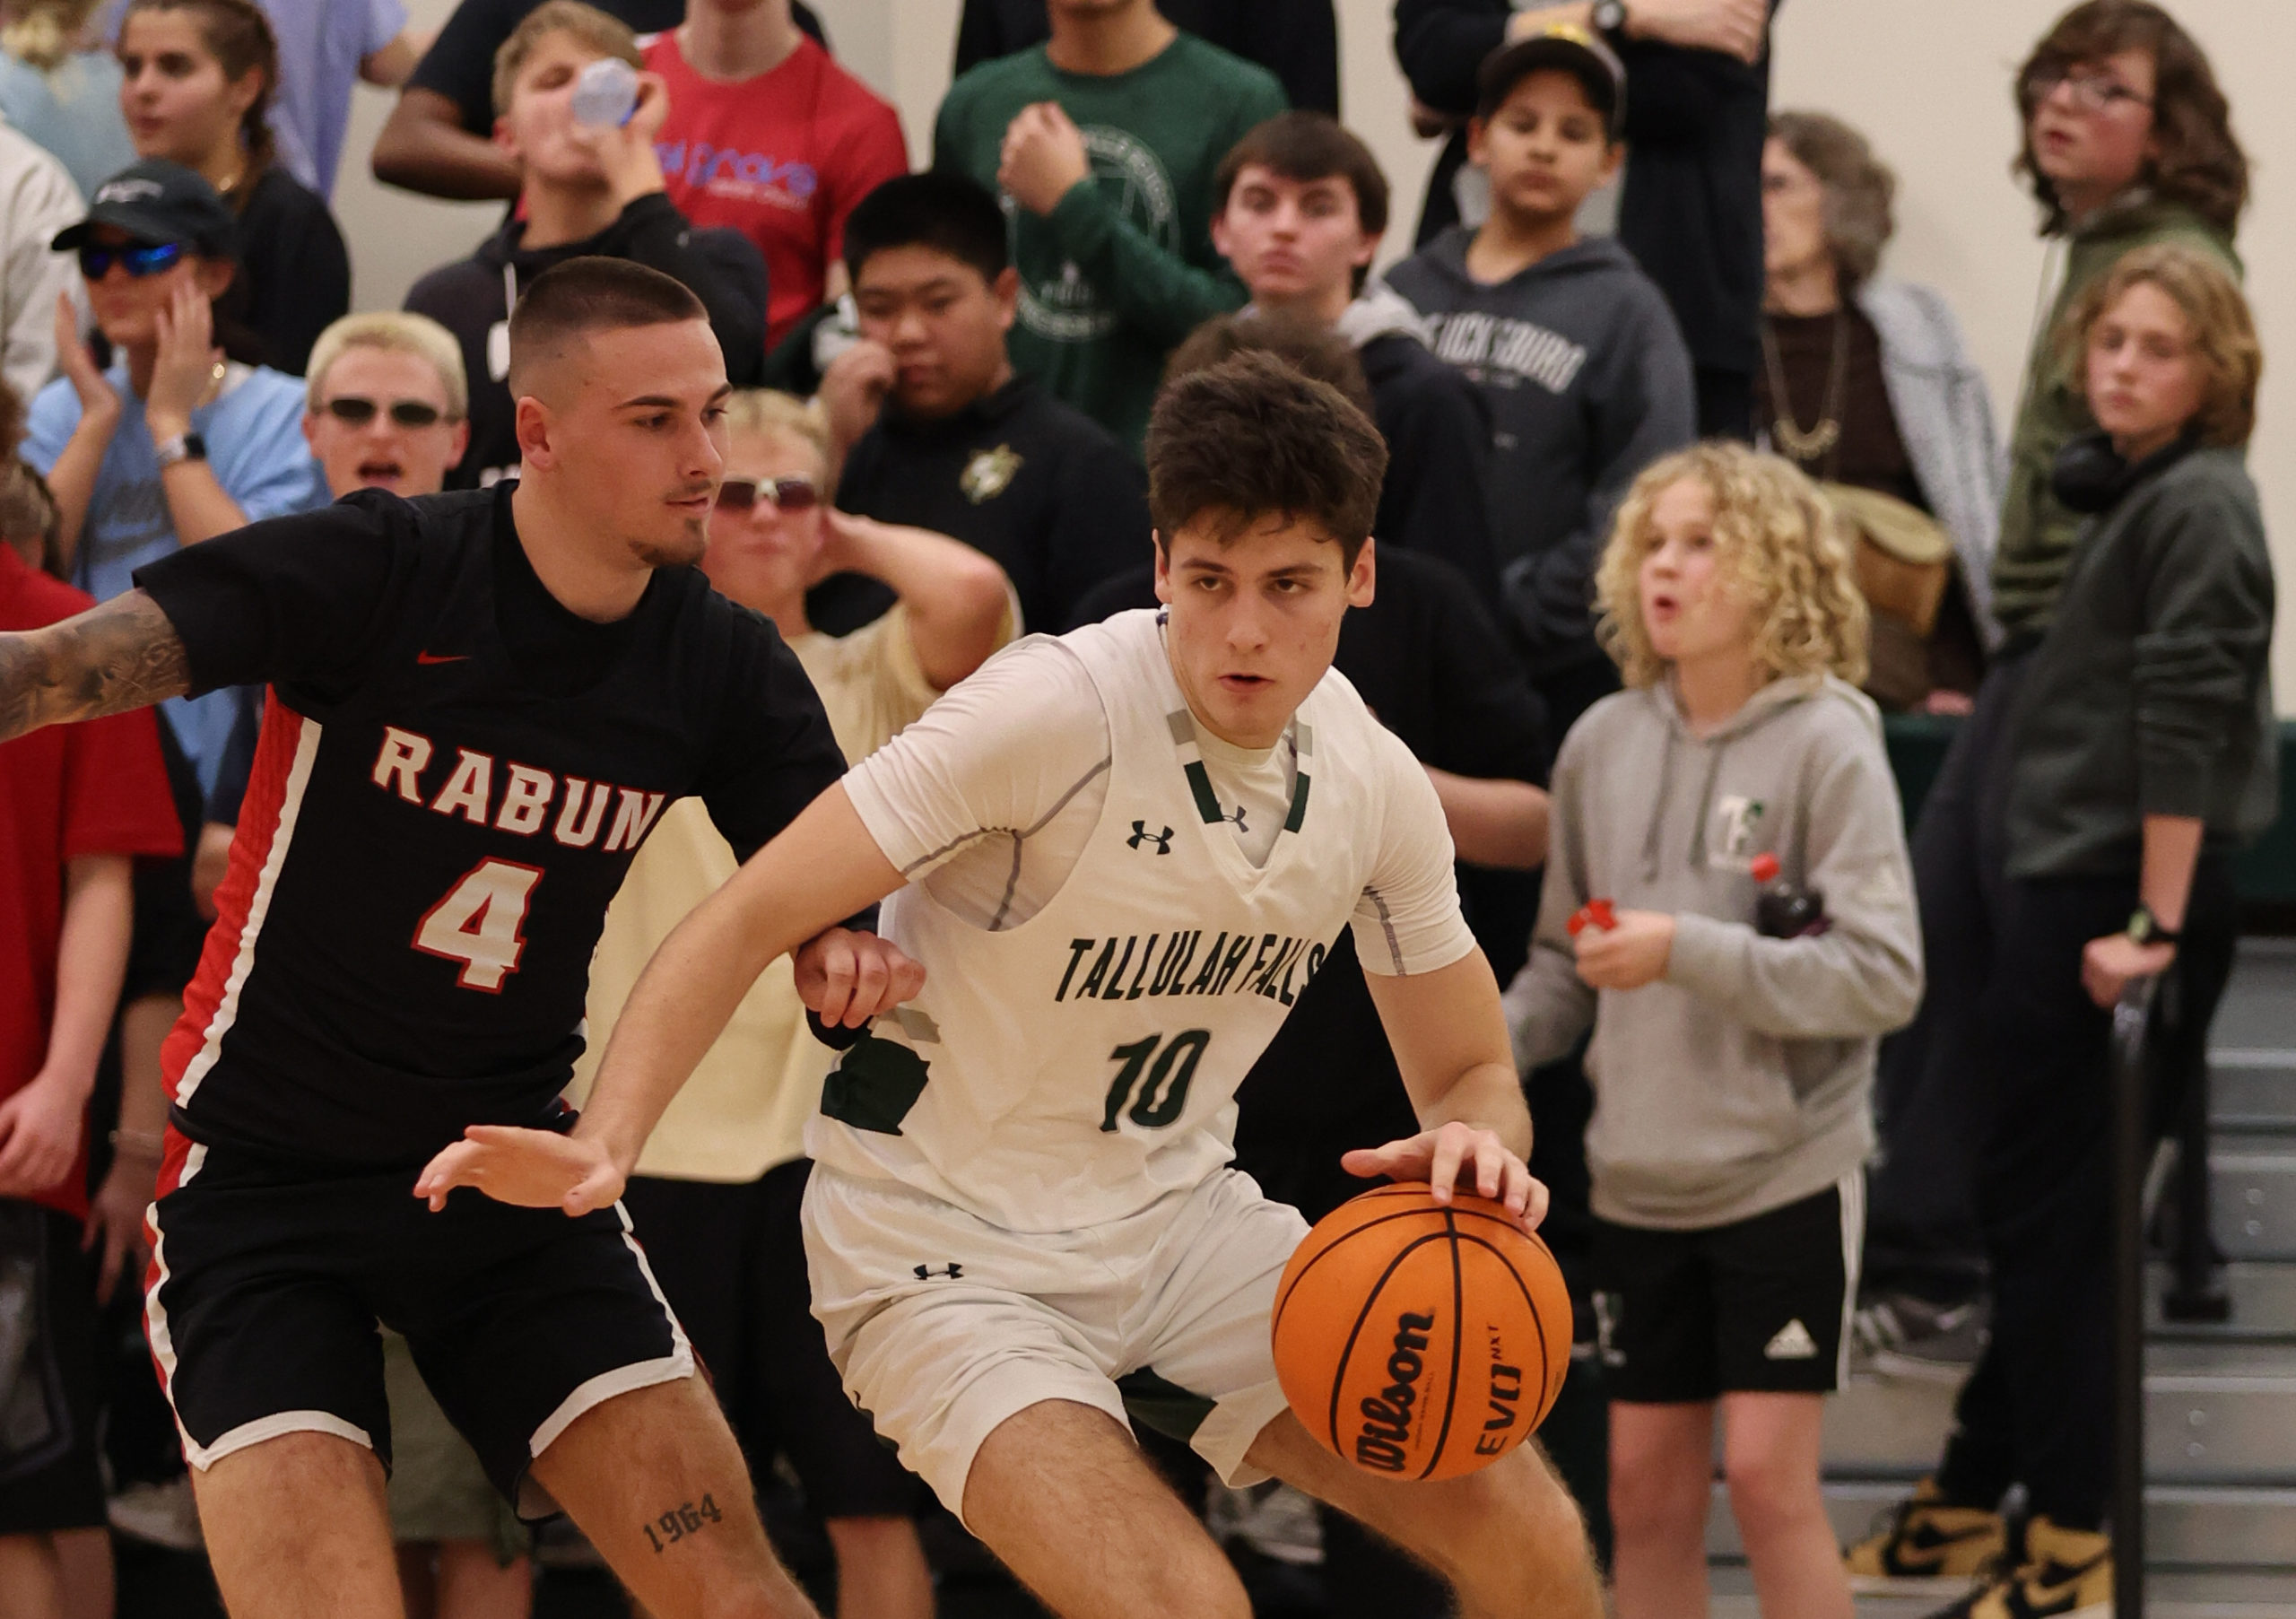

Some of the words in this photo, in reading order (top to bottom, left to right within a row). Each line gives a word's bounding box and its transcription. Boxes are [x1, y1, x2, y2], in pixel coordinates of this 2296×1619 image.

[370, 725, 665, 852] RABUN
[410, 856, 545, 995] 4
[1055, 930, 1255, 1003] TALLULAH
[1234, 933, 1326, 1007] FALLS
[1100, 1028, 1212, 1133] 10
[1486, 1321, 1504, 1361] NXT
[1356, 1310, 1434, 1472] Wilson
[1474, 1363, 1521, 1455] EVO
[643, 1493, 722, 1554] 1964
